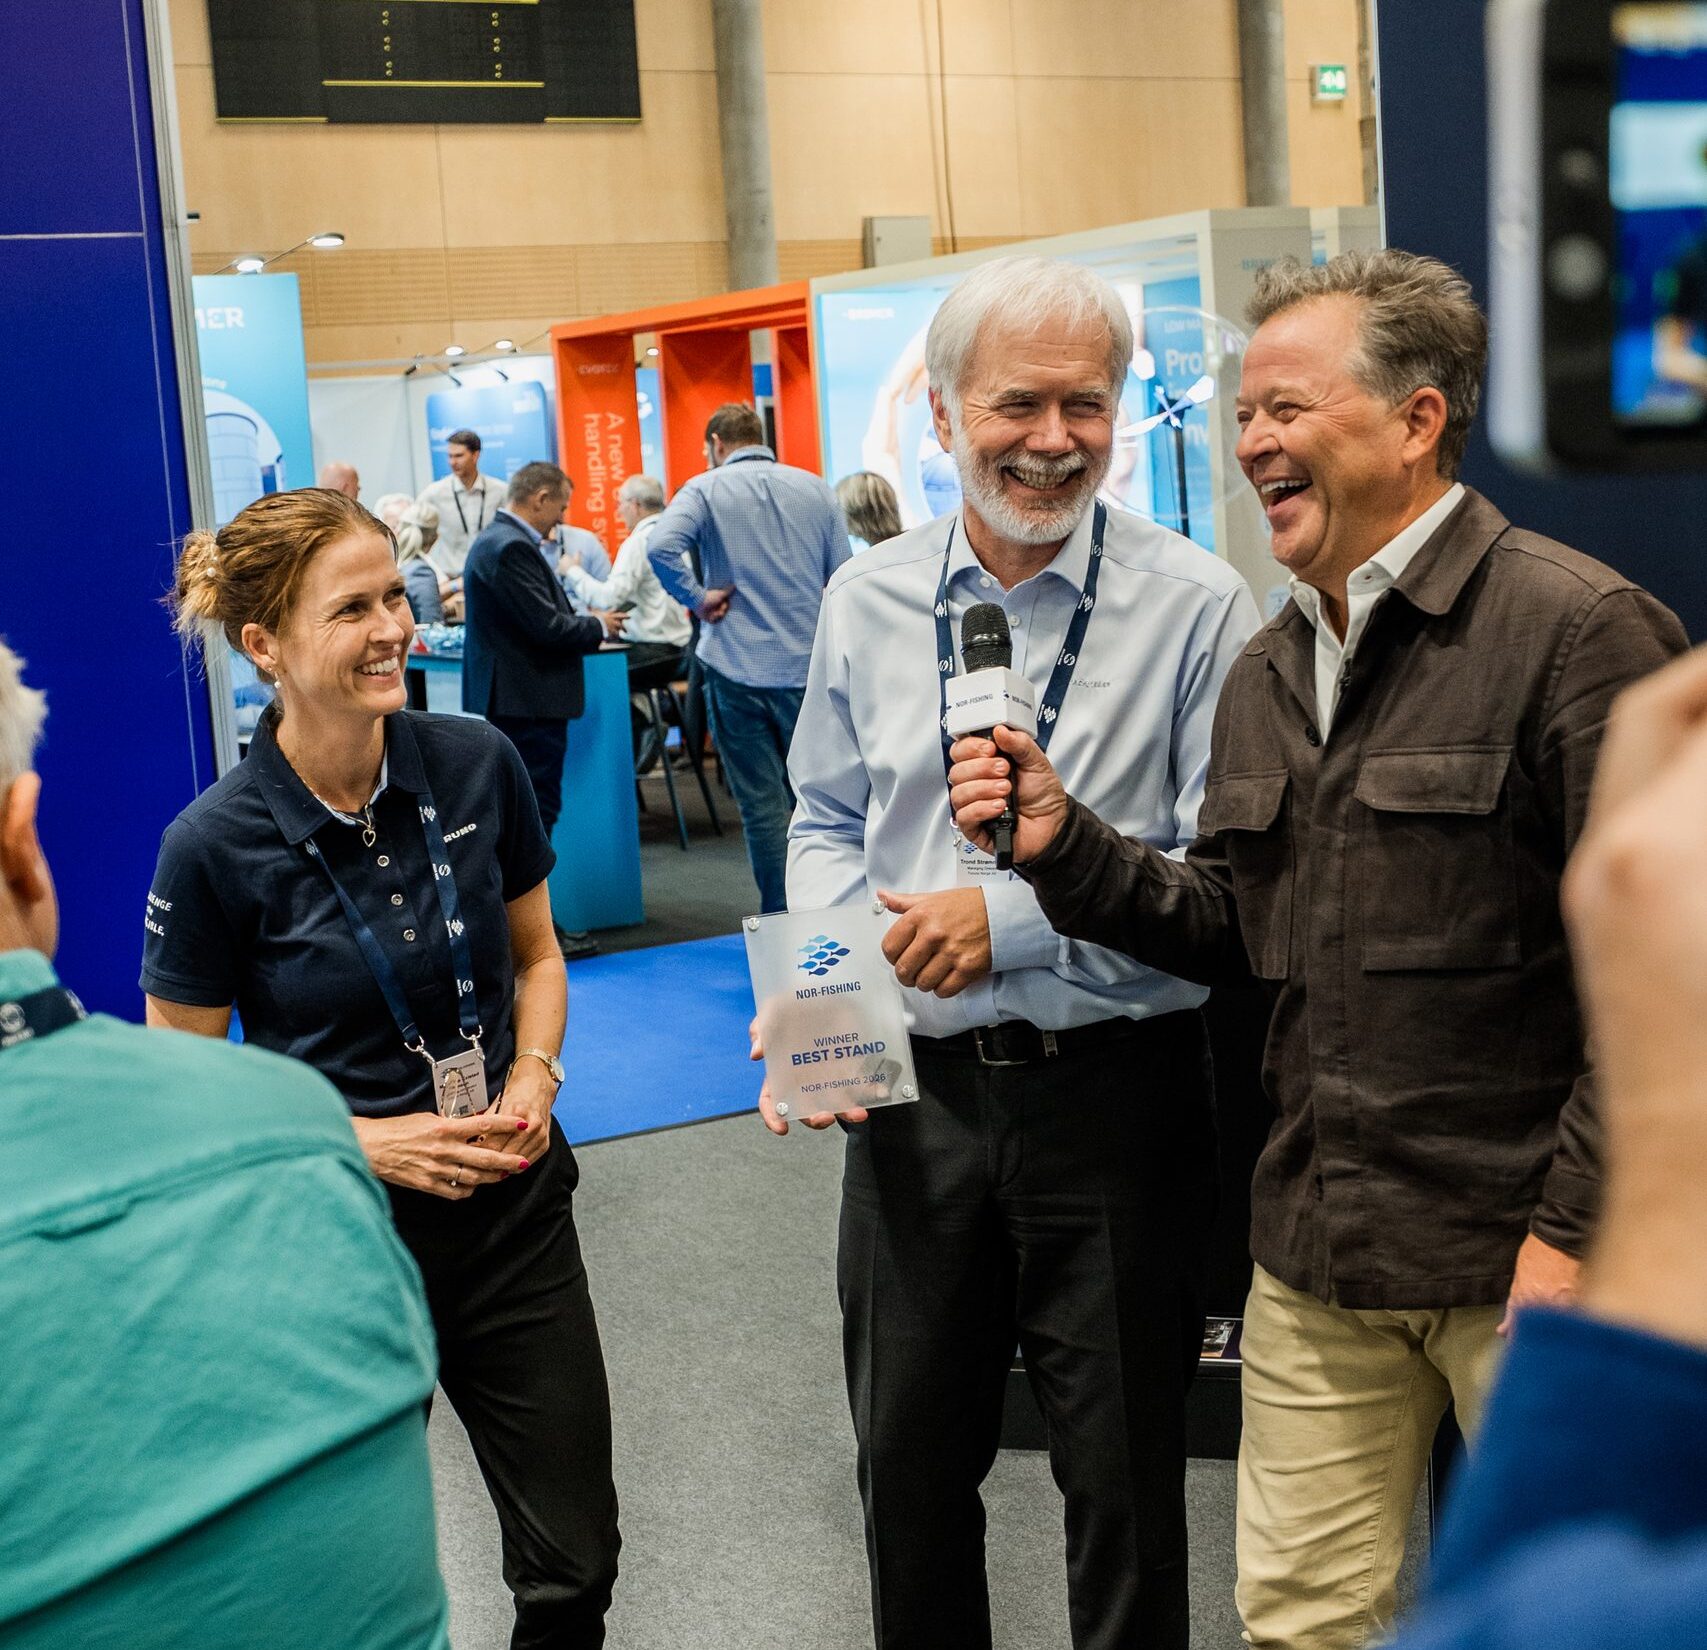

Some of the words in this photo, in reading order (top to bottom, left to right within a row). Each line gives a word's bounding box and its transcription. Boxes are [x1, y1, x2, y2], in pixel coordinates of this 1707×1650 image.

[606, 411, 625, 430] A
[583, 412, 607, 513] handling
[607, 434, 626, 482] new
[955, 693, 994, 709] NOR-FISHING
[796, 981, 861, 1000] NOR-FISHING
[814, 1032, 859, 1048] WINNER
[791, 1049, 829, 1066] BEST
[834, 1041, 886, 1059] STAND
[801, 1077, 861, 1093] NOR-FISHING
